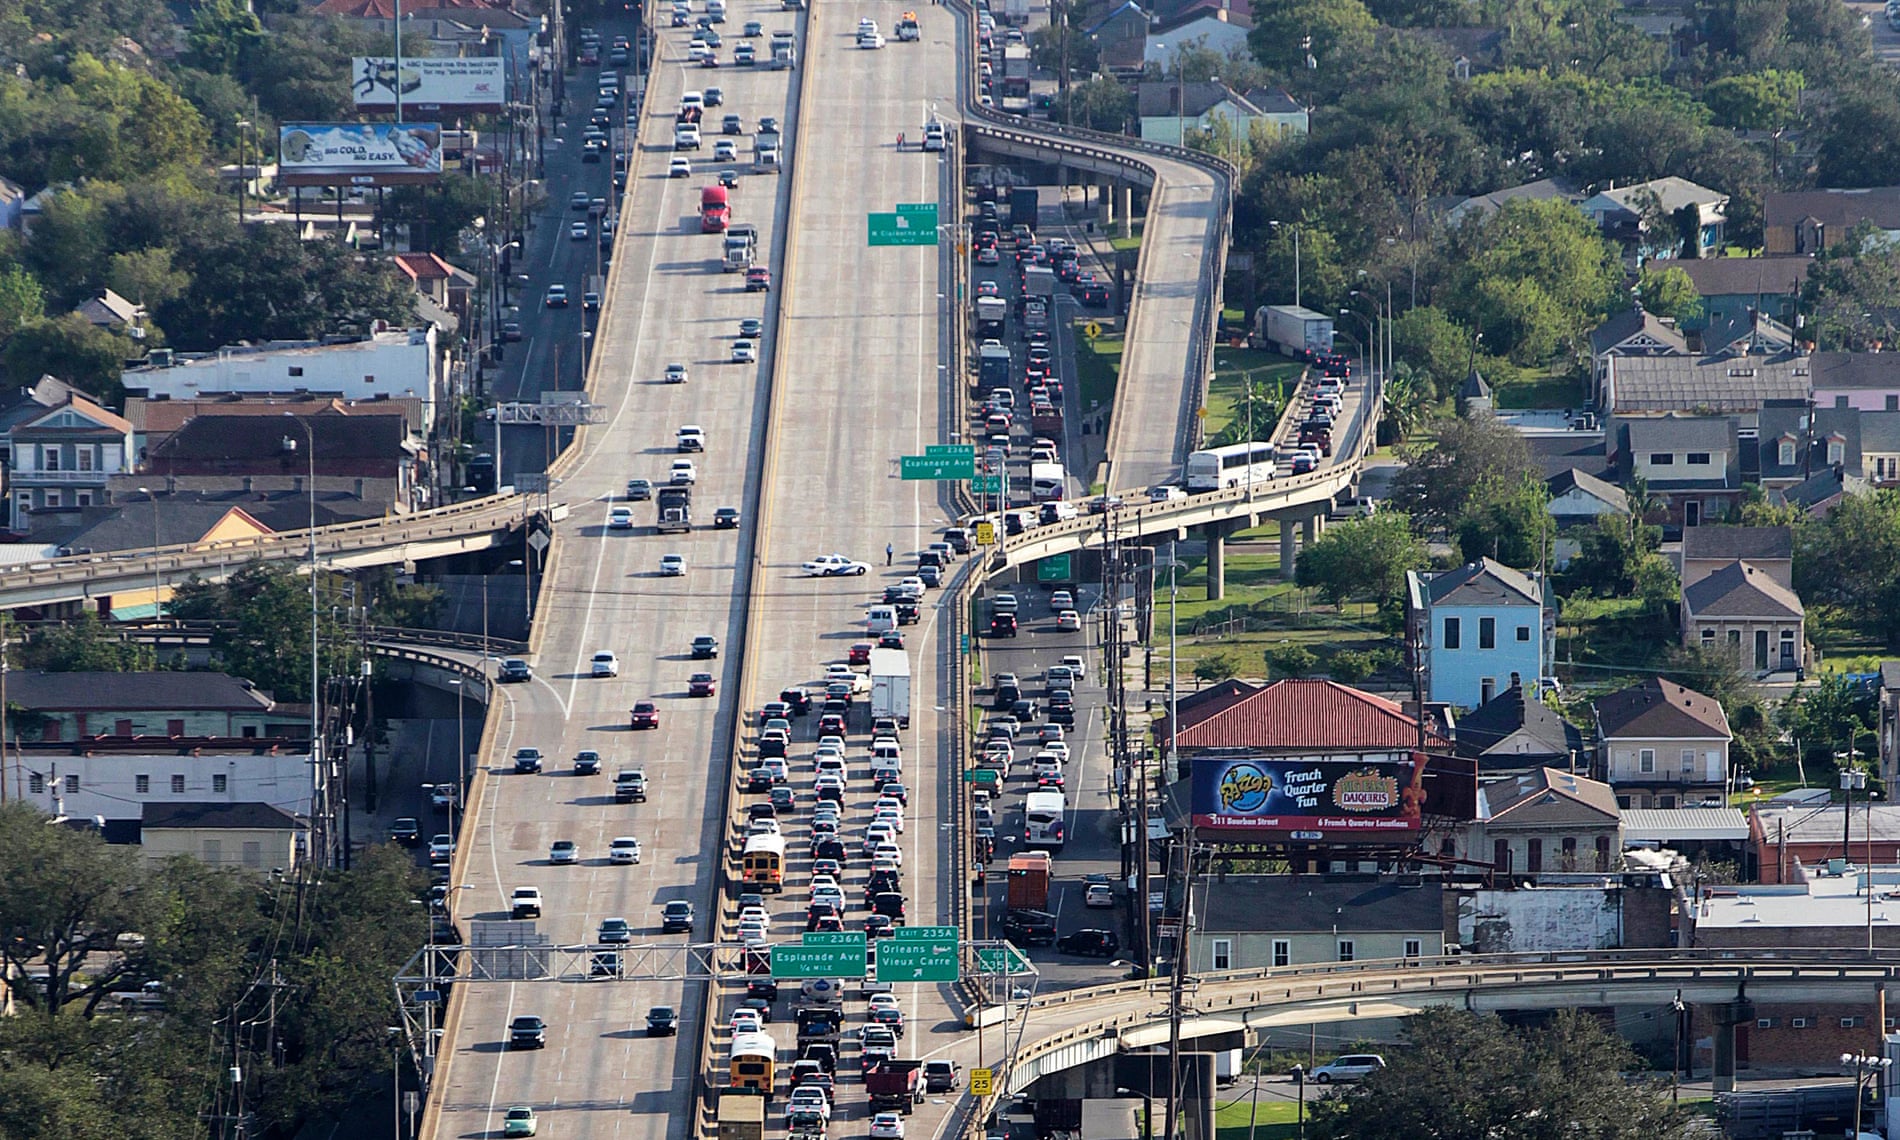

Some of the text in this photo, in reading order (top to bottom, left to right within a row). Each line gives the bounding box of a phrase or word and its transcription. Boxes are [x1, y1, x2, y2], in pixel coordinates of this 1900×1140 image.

[340, 146, 366, 154] COLD.
[368, 153, 394, 161] EASY.
[905, 460, 949, 468] Esplanade
[1285, 769, 1322, 783] French
[1283, 783, 1327, 797] Quarter
[1296, 795, 1317, 808] Fun
[1344, 794, 1387, 803] DAIQUIRIS
[1227, 817, 1256, 825] Bourbon
[1257, 818, 1278, 826] Street
[1318, 818, 1408, 828] 6 French Quarter Locations
[922, 929, 952, 937] 235A
[830, 935, 860, 943] 236A
[882, 944, 925, 953] Orleans
[777, 952, 861, 962] Esplanade Ave
[882, 957, 913, 966] Vieux
[975, 1080, 988, 1088] 25
